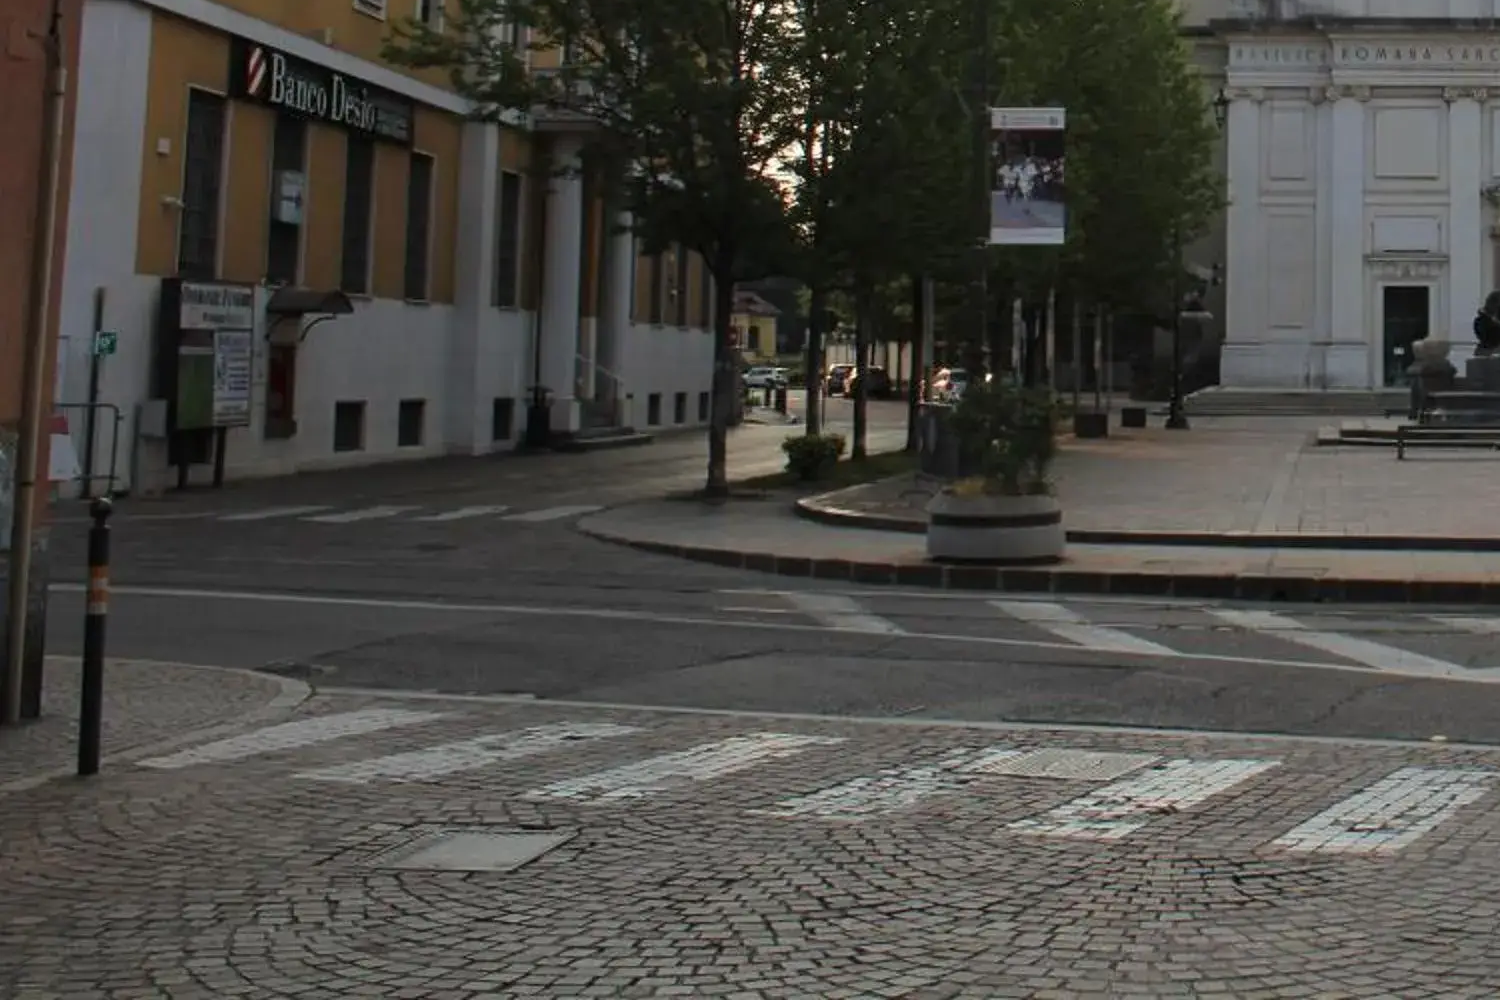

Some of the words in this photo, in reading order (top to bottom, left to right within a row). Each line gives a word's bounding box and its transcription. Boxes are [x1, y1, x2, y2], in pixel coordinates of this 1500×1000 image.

[1341, 46, 1432, 62] ROMANA
[271, 54, 327, 117] Banco
[330, 75, 376, 131] Desio
